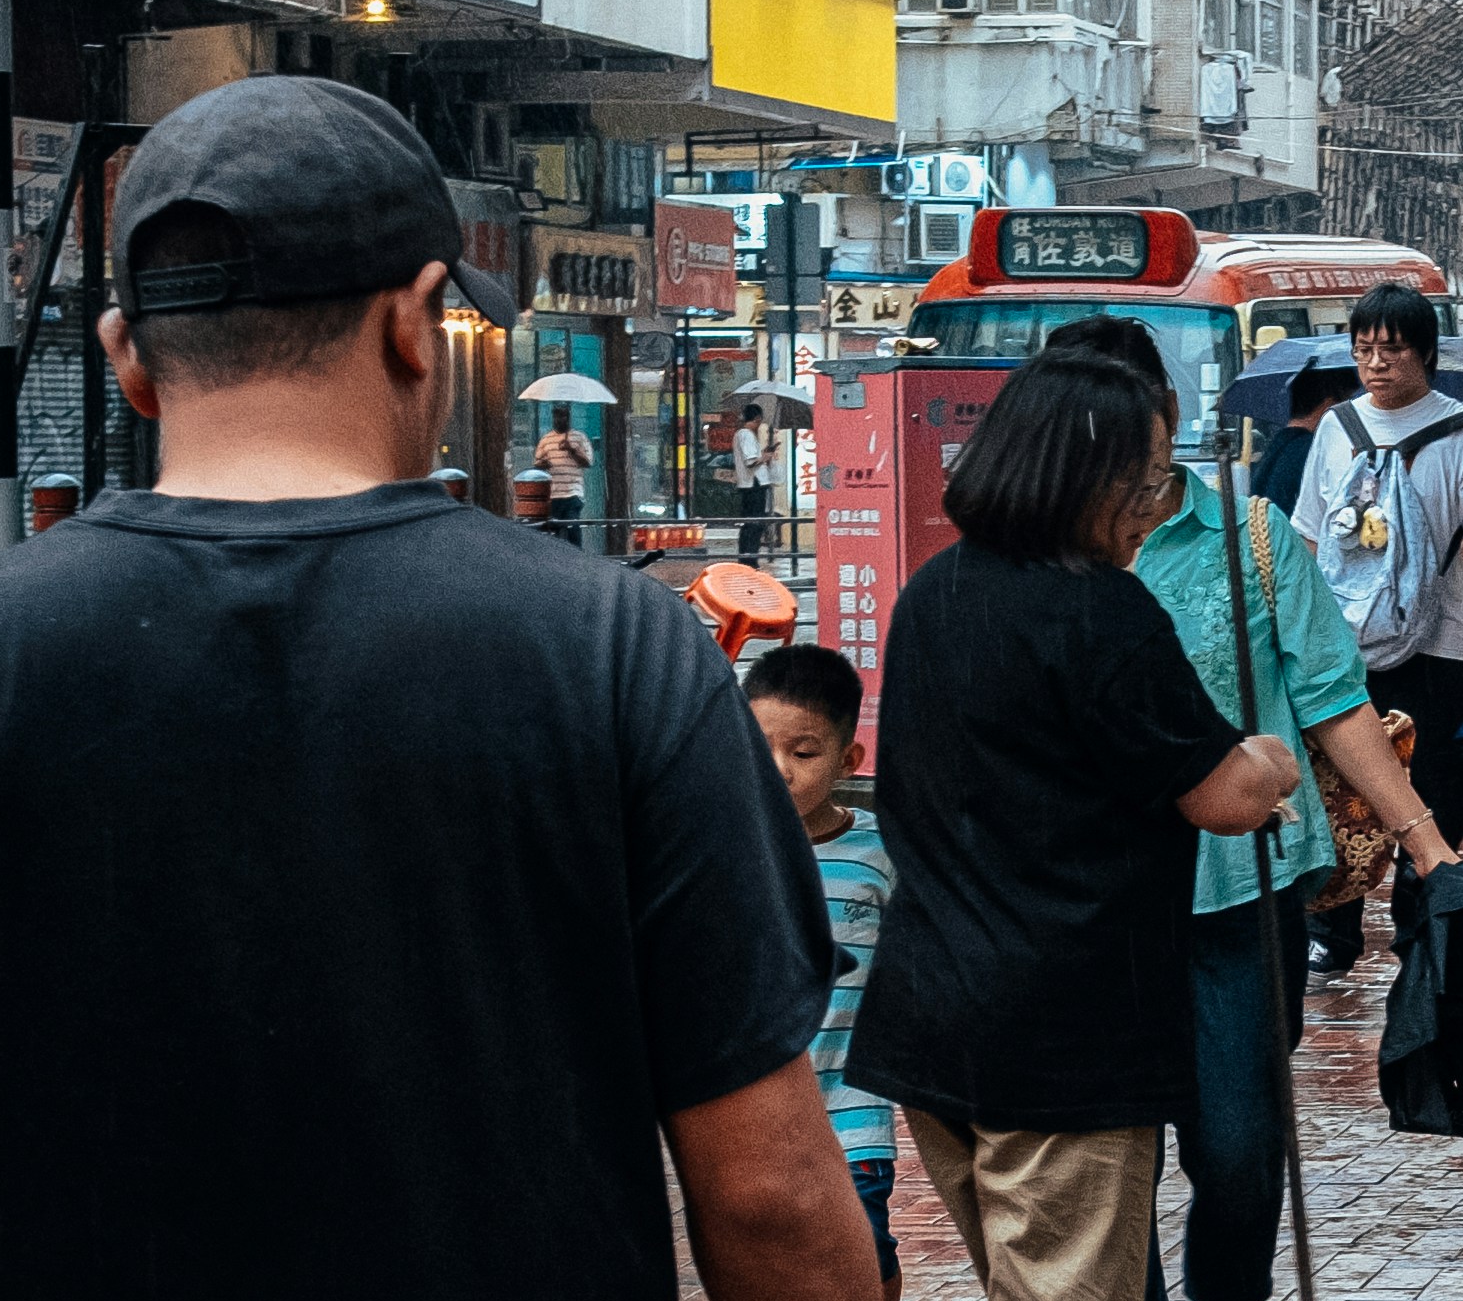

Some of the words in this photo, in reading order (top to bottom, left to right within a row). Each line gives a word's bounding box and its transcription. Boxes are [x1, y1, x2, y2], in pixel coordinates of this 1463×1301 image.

[1032, 230, 1142, 269] 佐敦道
[832, 288, 915, 323] 金山
